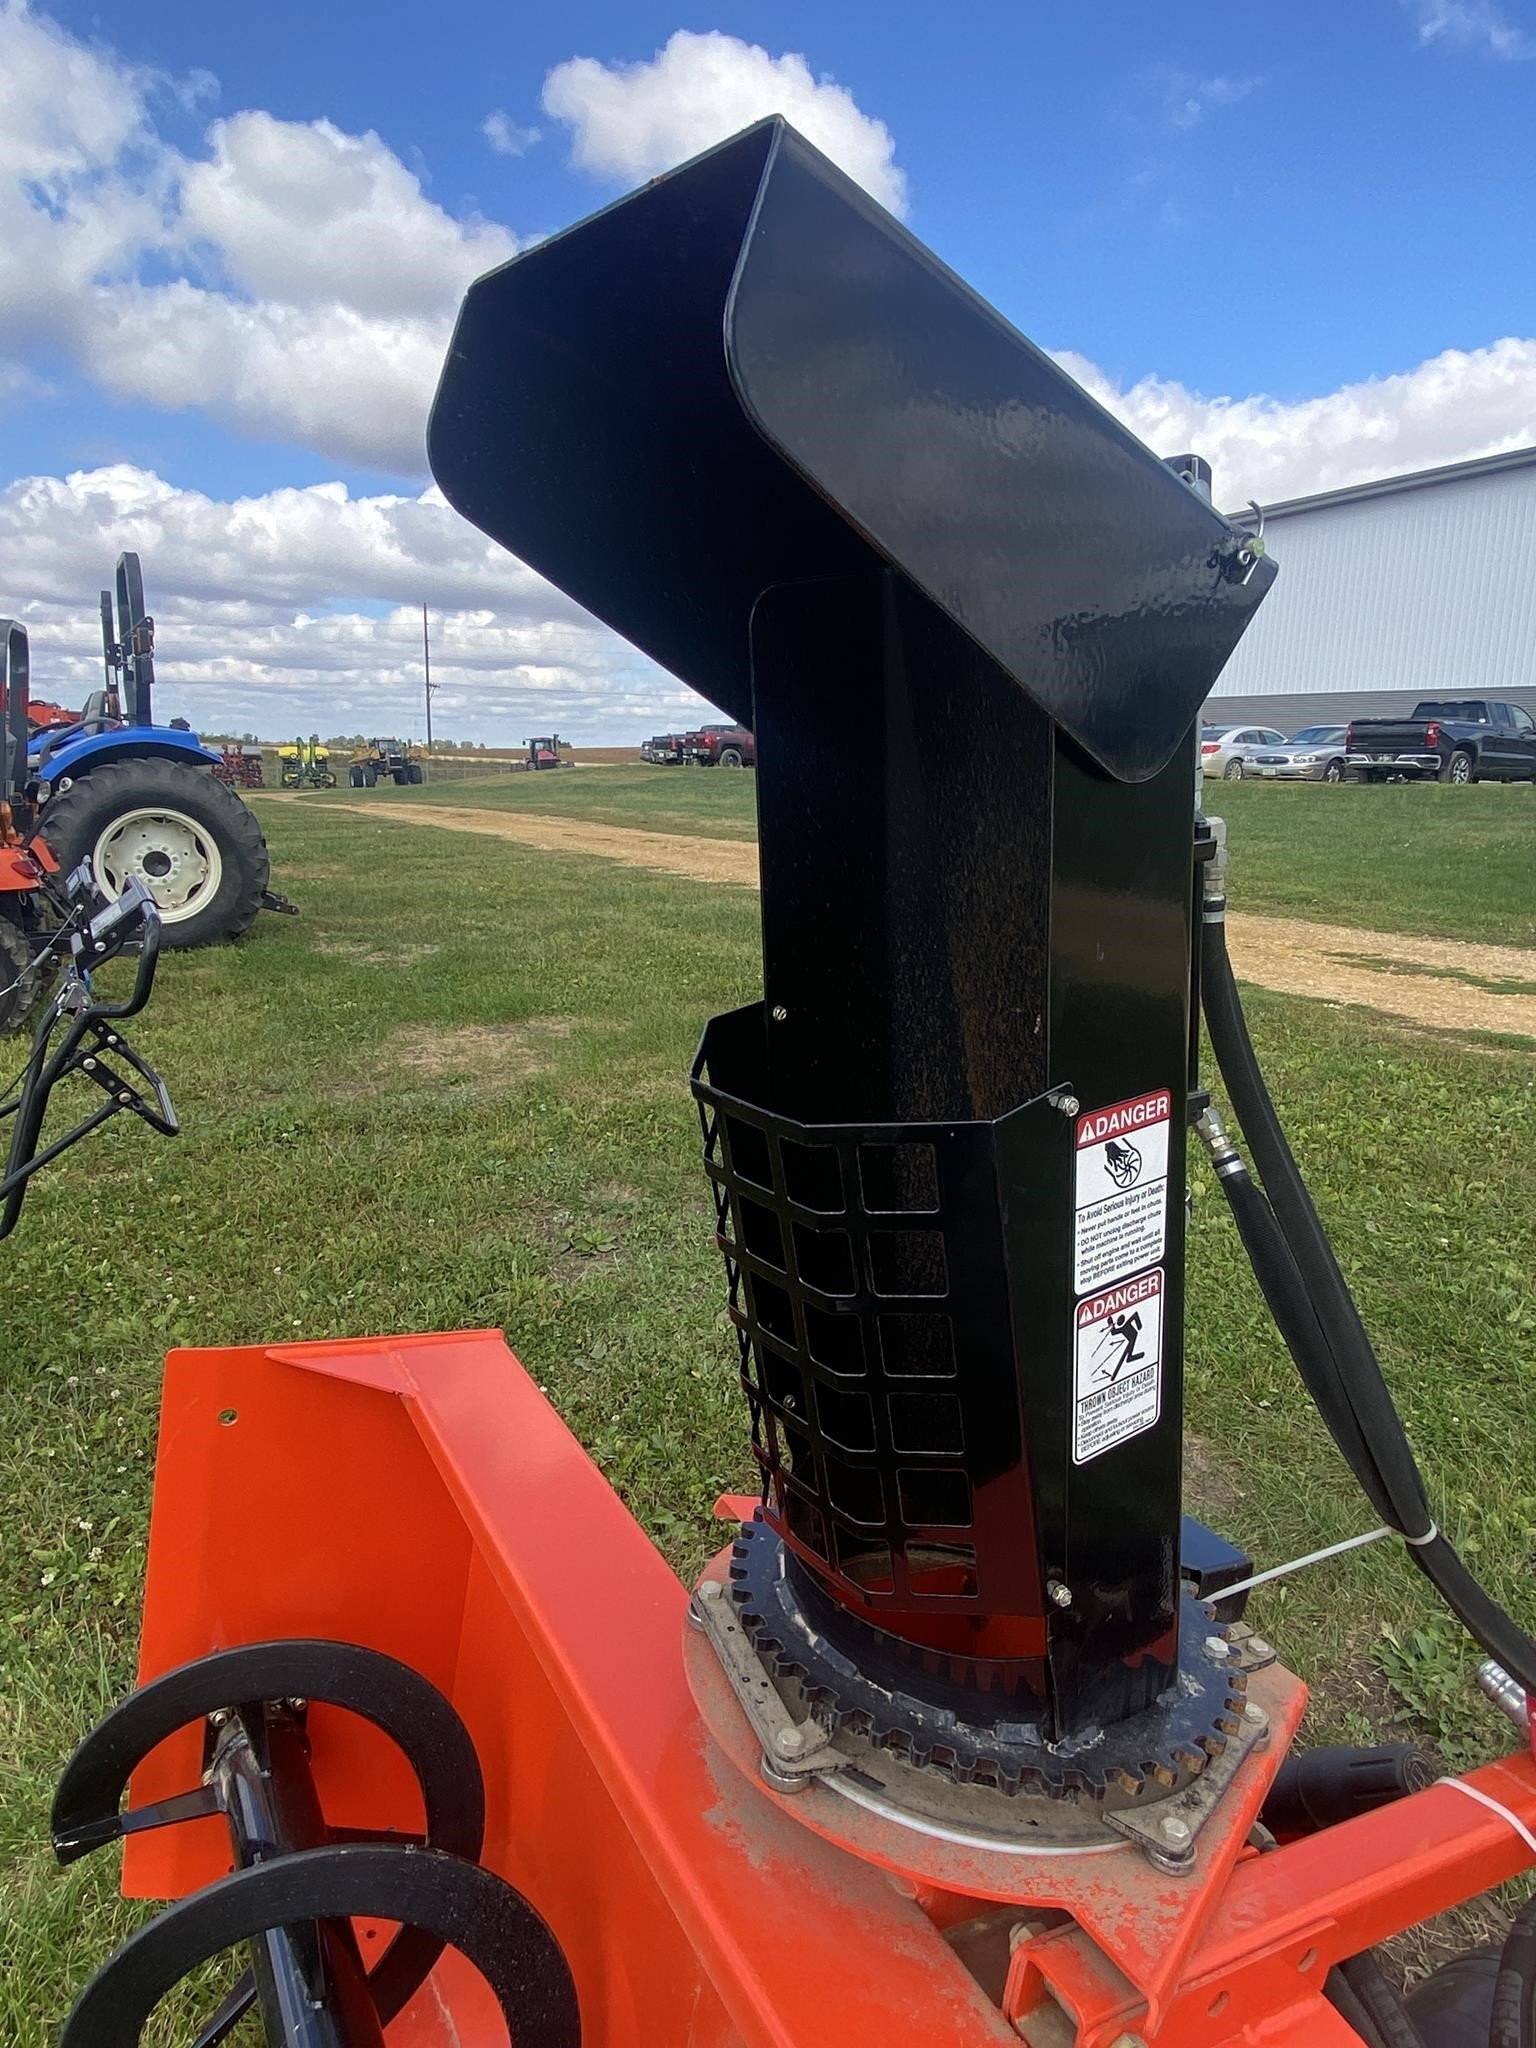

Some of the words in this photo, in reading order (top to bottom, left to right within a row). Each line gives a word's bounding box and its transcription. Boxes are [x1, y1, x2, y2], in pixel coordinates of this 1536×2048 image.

[1096, 1096, 1168, 1136] DANGER
[1078, 1214, 1085, 1224] To
[1087, 1206, 1102, 1220] Avoid
[1104, 1200, 1124, 1214] Serious
[1125, 1194, 1140, 1206] Injury
[1141, 1191, 1147, 1199] or
[1081, 1224, 1096, 1234] Never
[1098, 1220, 1106, 1230] put
[1108, 1214, 1123, 1224] hands
[1124, 1210, 1130, 1218] or
[1081, 1237, 1089, 1246] DO
[1090, 1232, 1102, 1242] NOT
[1103, 1226, 1121, 1237] unclog
[1122, 1216, 1146, 1230] discharge
[1147, 1210, 1161, 1220] chute
[1081, 1245, 1095, 1254] while
[1096, 1236, 1118, 1249] machine
[1080, 1257, 1093, 1267] Shut
[1102, 1247, 1119, 1258] engine
[1120, 1241, 1130, 1250] and
[1131, 1237, 1141, 1246] wait
[1080, 1264, 1099, 1276] moving
[1100, 1258, 1113, 1268] parts
[1114, 1252, 1128, 1261] come
[1140, 1238, 1162, 1251] complete
[1093, 1265, 1115, 1279] BEFORE
[1134, 1252, 1149, 1263] power
[1092, 1275, 1159, 1318] DANGER
[1081, 1392, 1106, 1413] THROWN
[1108, 1379, 1130, 1400] OBJECT
[1132, 1368, 1154, 1388] HAZARD
